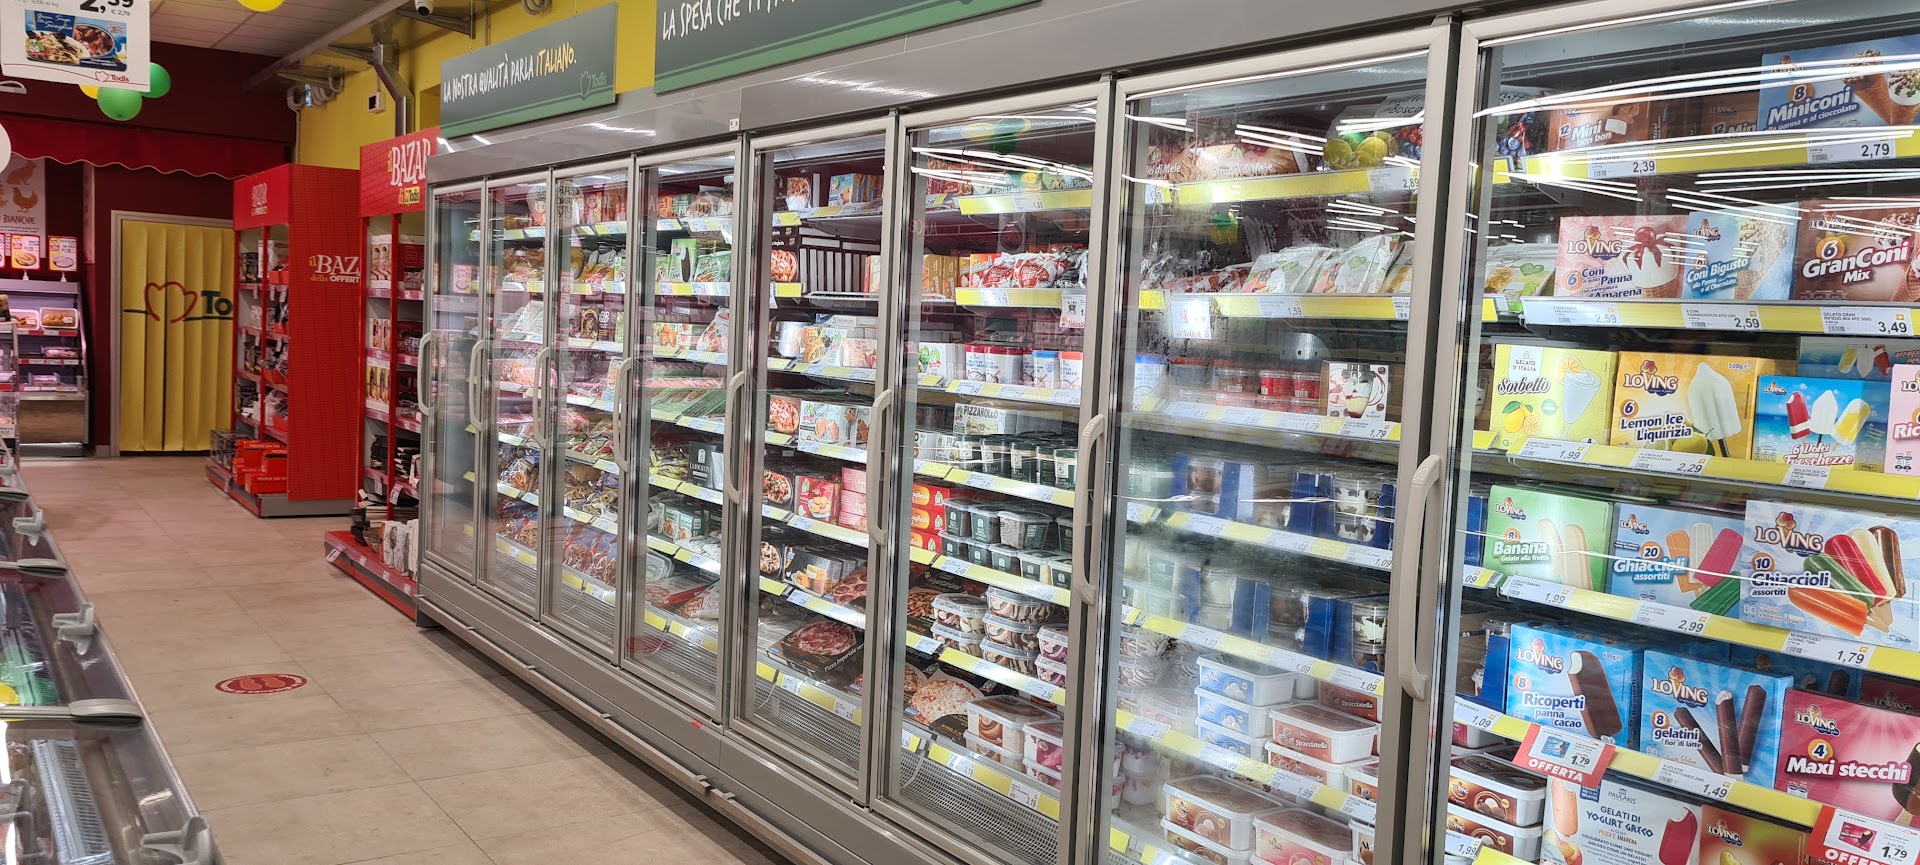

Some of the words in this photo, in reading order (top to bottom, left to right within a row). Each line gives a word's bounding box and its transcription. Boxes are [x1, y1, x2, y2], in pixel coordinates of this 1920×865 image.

[662, 11, 676, 41] LA
[680, 1, 713, 37] SPESA
[717, 0, 741, 27] CHE
[110, 74, 130, 83] Todis
[443, 80, 451, 103] LA
[452, 75, 478, 103] NOSTRA
[479, 52, 509, 94] QUALITÀ
[510, 61, 534, 86] PARLA
[590, 71, 607, 90] Todis
[1793, 84, 1807, 102] 8
[1768, 87, 1851, 126] Miniconi
[1809, 114, 1817, 122] al
[1818, 103, 1857, 120] cioccolato
[1560, 124, 1571, 137] 12
[1571, 120, 1602, 141] Mini
[1728, 122, 1757, 133] Min
[1577, 136, 1594, 148] bon
[1595, 131, 1612, 143] bon
[1861, 143, 1890, 159] 2,79
[1162, 162, 1182, 174] Mele
[1251, 162, 1273, 173] Mele
[1632, 160, 1655, 175] 2,39
[1402, 177, 1420, 189] 2,89
[3, 214, 37, 224] BIANCHE
[1693, 228, 1720, 238] LOVING
[1567, 236, 1623, 258] LOVING
[1820, 240, 1838, 260] 6
[309, 256, 317, 267] il
[315, 254, 360, 276] BAZ
[1802, 240, 1909, 278] GranConi
[1566, 272, 1577, 287] 6
[1582, 267, 1605, 278] Coni
[1687, 269, 1708, 284] Coni
[1711, 258, 1749, 279] Bigusto
[1843, 270, 1870, 284] Mix
[329, 275, 361, 284] OFFERT
[1600, 273, 1633, 285] Panna
[1701, 278, 1717, 287] Panna
[201, 290, 233, 316] To
[1288, 307, 1302, 317] 1,59
[1594, 313, 1617, 325] 2,59
[1734, 317, 1760, 330] 2,59
[1878, 321, 1907, 335] 3,49
[1512, 364, 1537, 373] D'ITALIA
[1728, 362, 1744, 370] 500g
[1497, 375, 1551, 395] Sorbetto
[1624, 372, 1678, 391] LOVING
[1763, 385, 1785, 394] LOVING
[963, 405, 998, 420] PIZZAROLLO
[1624, 400, 1634, 414] 6
[1620, 417, 1662, 430] Lemon
[1666, 413, 1684, 425] Ice
[1369, 429, 1387, 439] 1,79
[1636, 425, 1692, 443] Liquirizia
[1894, 423, 1920, 440] Ric
[1559, 450, 1581, 460] 1,99
[1792, 443, 1799, 455] 6
[1803, 441, 1830, 455] Dolci
[1784, 452, 1854, 467] Freschezze
[1676, 462, 1703, 474] 2,29
[1495, 503, 1524, 517] LOVING
[1619, 519, 1648, 531] LOVING
[1755, 526, 1823, 551] LOVING
[1493, 541, 1547, 555] Banana
[1643, 547, 1659, 557] 20
[1375, 558, 1393, 569] 1,09
[1520, 554, 1531, 562] alla
[1532, 554, 1549, 562] frutta
[1612, 556, 1687, 574] Ghiaccioli
[1756, 558, 1771, 570] 10
[1633, 571, 1671, 581] assortiti
[1752, 571, 1829, 587] Ghiaccioli
[1544, 592, 1566, 604] 1,99
[1751, 586, 1786, 596] assortiti
[1678, 619, 1704, 633] 2,99
[1203, 637, 1218, 647] 1,09
[1516, 647, 1564, 671] LOVING
[1836, 649, 1865, 665] 1,79
[1295, 663, 1311, 674] 1,09
[1360, 681, 1378, 692] 1,09
[1518, 677, 1527, 689] 8
[1652, 677, 1709, 705] LOVING
[1341, 700, 1374, 710] Stracciatella
[1524, 693, 1585, 711] Ricoperti
[1534, 707, 1565, 720] panna
[1656, 714, 1664, 725] 8
[1472, 714, 1491, 729] 1,09
[1554, 719, 1582, 728] cacao
[1795, 711, 1836, 731] LOVING
[1654, 728, 1698, 741] gelatini
[1295, 739, 1328, 750] Stracciatella
[1664, 739, 1676, 747] fior
[1685, 741, 1702, 749] latte
[1813, 744, 1826, 757] 4
[1571, 755, 1590, 766] 1,79
[1528, 758, 1584, 783] OFFERTA
[1787, 756, 1835, 776] Maxi
[1838, 760, 1909, 781] stecchi
[1297, 786, 1314, 799] 1,99
[1703, 783, 1728, 798] 1,49
[1608, 791, 1637, 805] PAVLAKIS
[1600, 805, 1630, 821] GELATI
[1631, 816, 1641, 824] DI
[1586, 810, 1623, 829] YOGURT
[1625, 823, 1654, 838] GRECO
[1598, 829, 1612, 838] PESCA
[1616, 835, 1637, 846] AMARENA
[1707, 825, 1740, 841] LOVING
[1458, 844, 1477, 857] 1,99
[1606, 846, 1620, 854] COME
[1609, 842, 1623, 850] COME
[1881, 846, 1908, 859] 1,79
